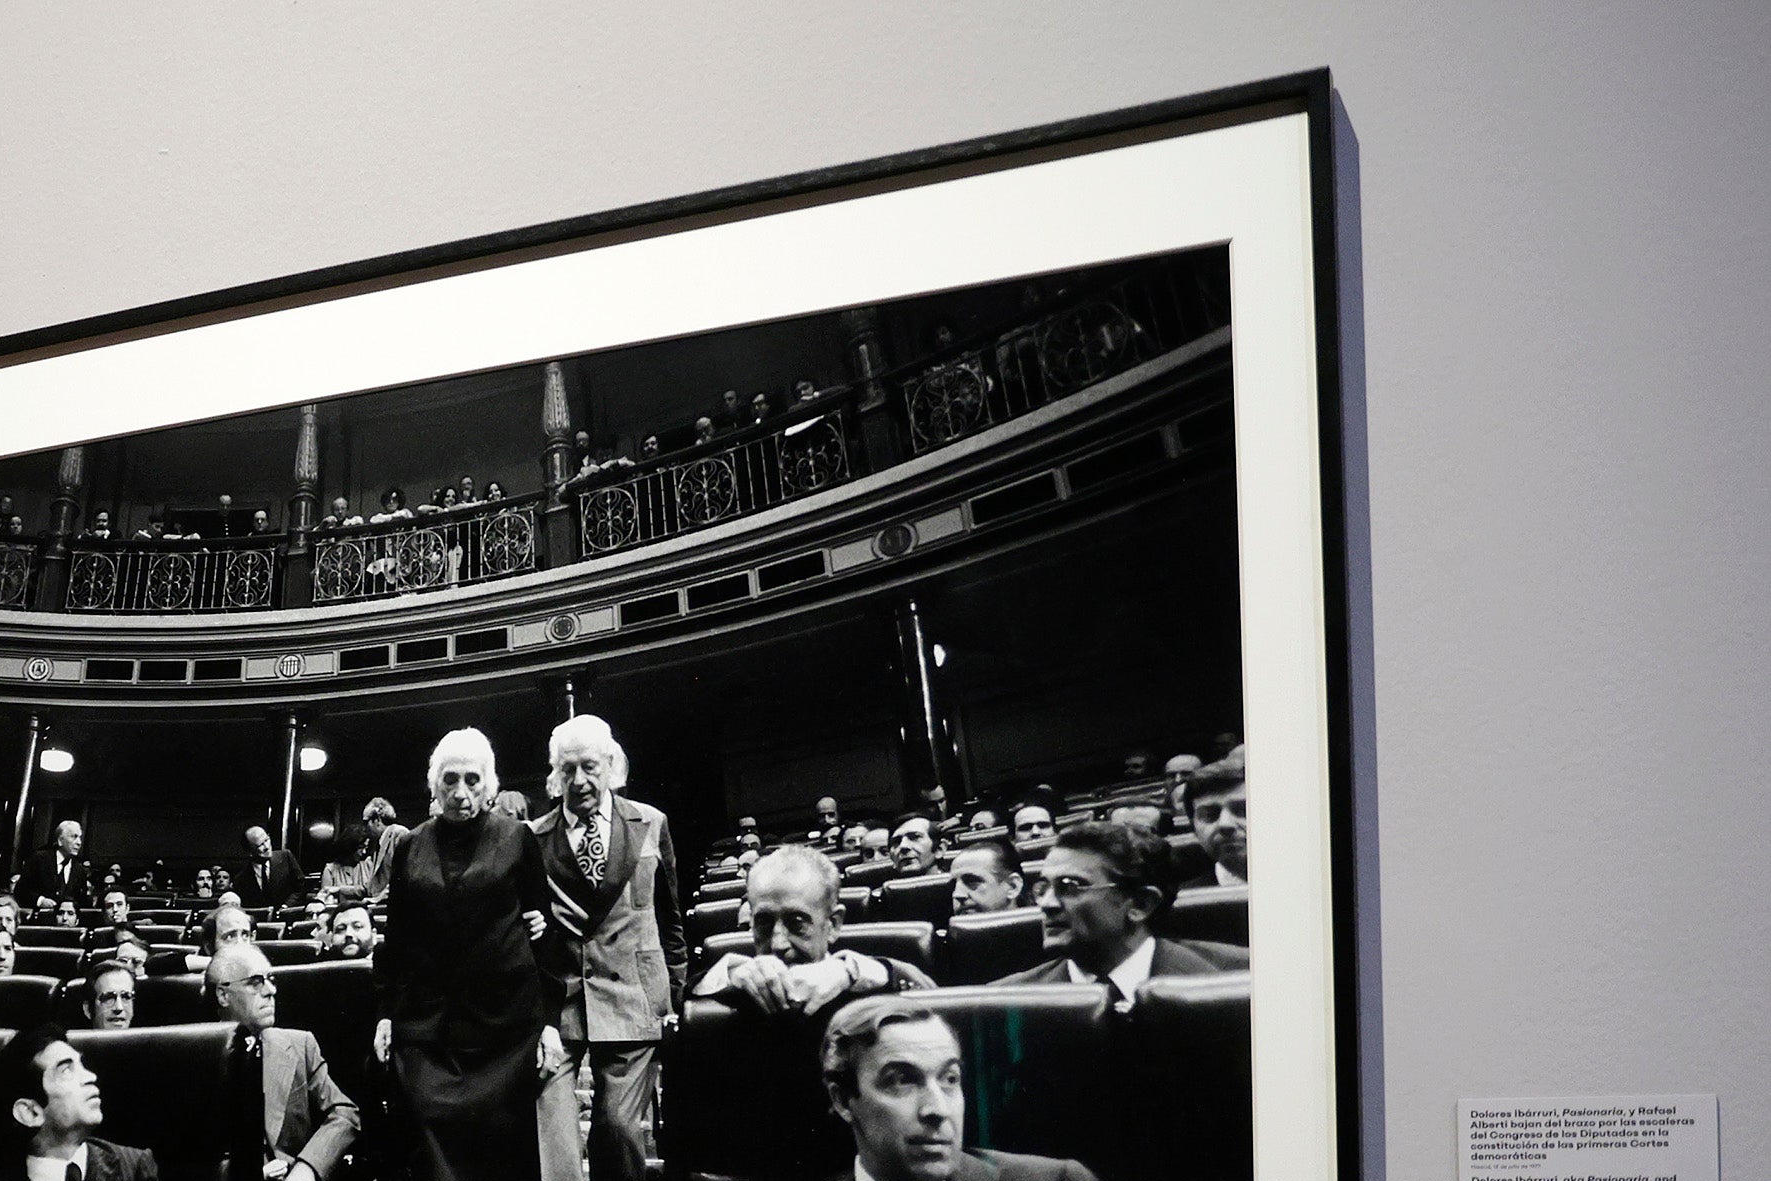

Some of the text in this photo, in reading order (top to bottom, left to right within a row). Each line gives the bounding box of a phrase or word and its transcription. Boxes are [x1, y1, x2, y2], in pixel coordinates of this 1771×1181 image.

[1471, 1106, 1676, 1118] Dolores Ibárruri, Pasionaria, y Rafael
[1471, 1152, 1546, 1160] democráticas
